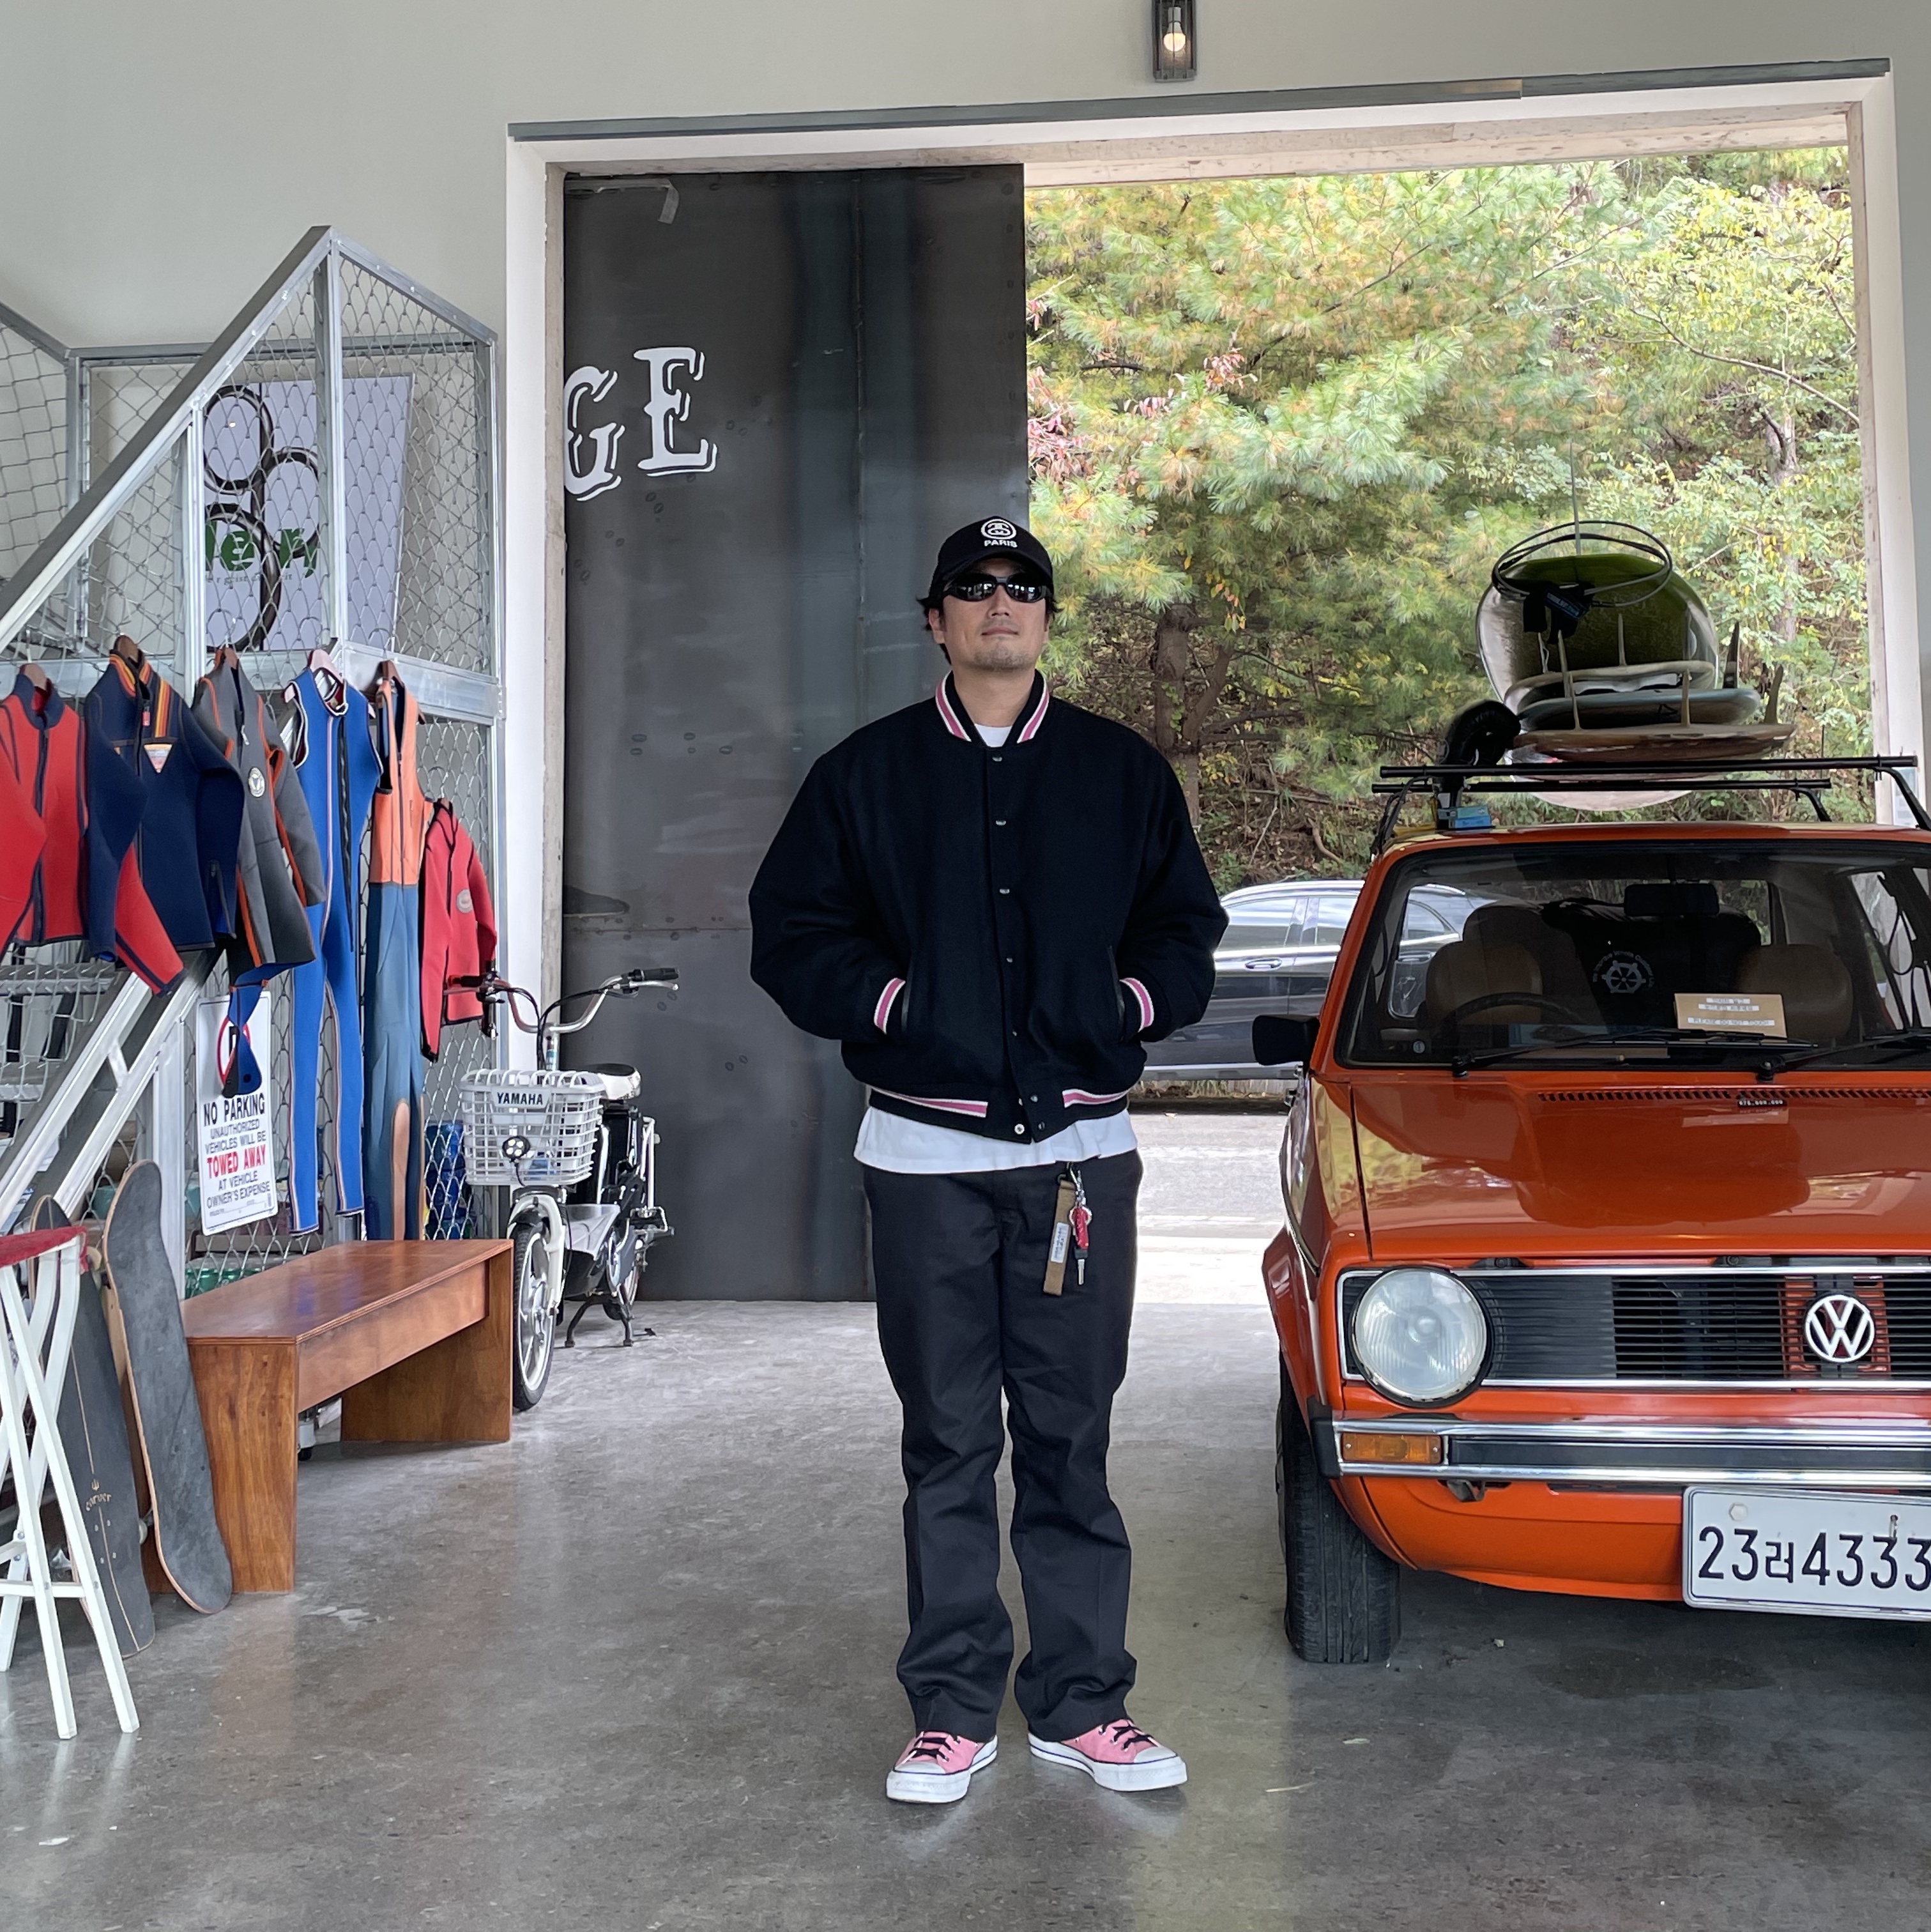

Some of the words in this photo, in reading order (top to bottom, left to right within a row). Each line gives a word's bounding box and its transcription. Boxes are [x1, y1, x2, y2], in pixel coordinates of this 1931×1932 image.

[564, 346, 717, 502] GE
[984, 539, 1018, 548] PARIS
[204, 1101, 218, 1127] NO
[224, 1092, 265, 1123] PARKING
[497, 1092, 543, 1106] YAMAHA
[204, 1137, 238, 1154] VEHICLES
[240, 1133, 255, 1147] WILL
[257, 1130, 266, 1143] BE
[210, 1118, 259, 1139] UNAUTHORIZED
[207, 1151, 239, 1179] TOWED
[243, 1144, 266, 1170] AWAY
[218, 1178, 227, 1191] AT
[229, 1170, 258, 1188] VEHICLE
[206, 1190, 239, 1209] OWNER'S
[240, 1181, 270, 1200] EXPENSE
[1807, 1296, 1874, 1361] VW
[1698, 1526, 1931, 1591] 23러4333
